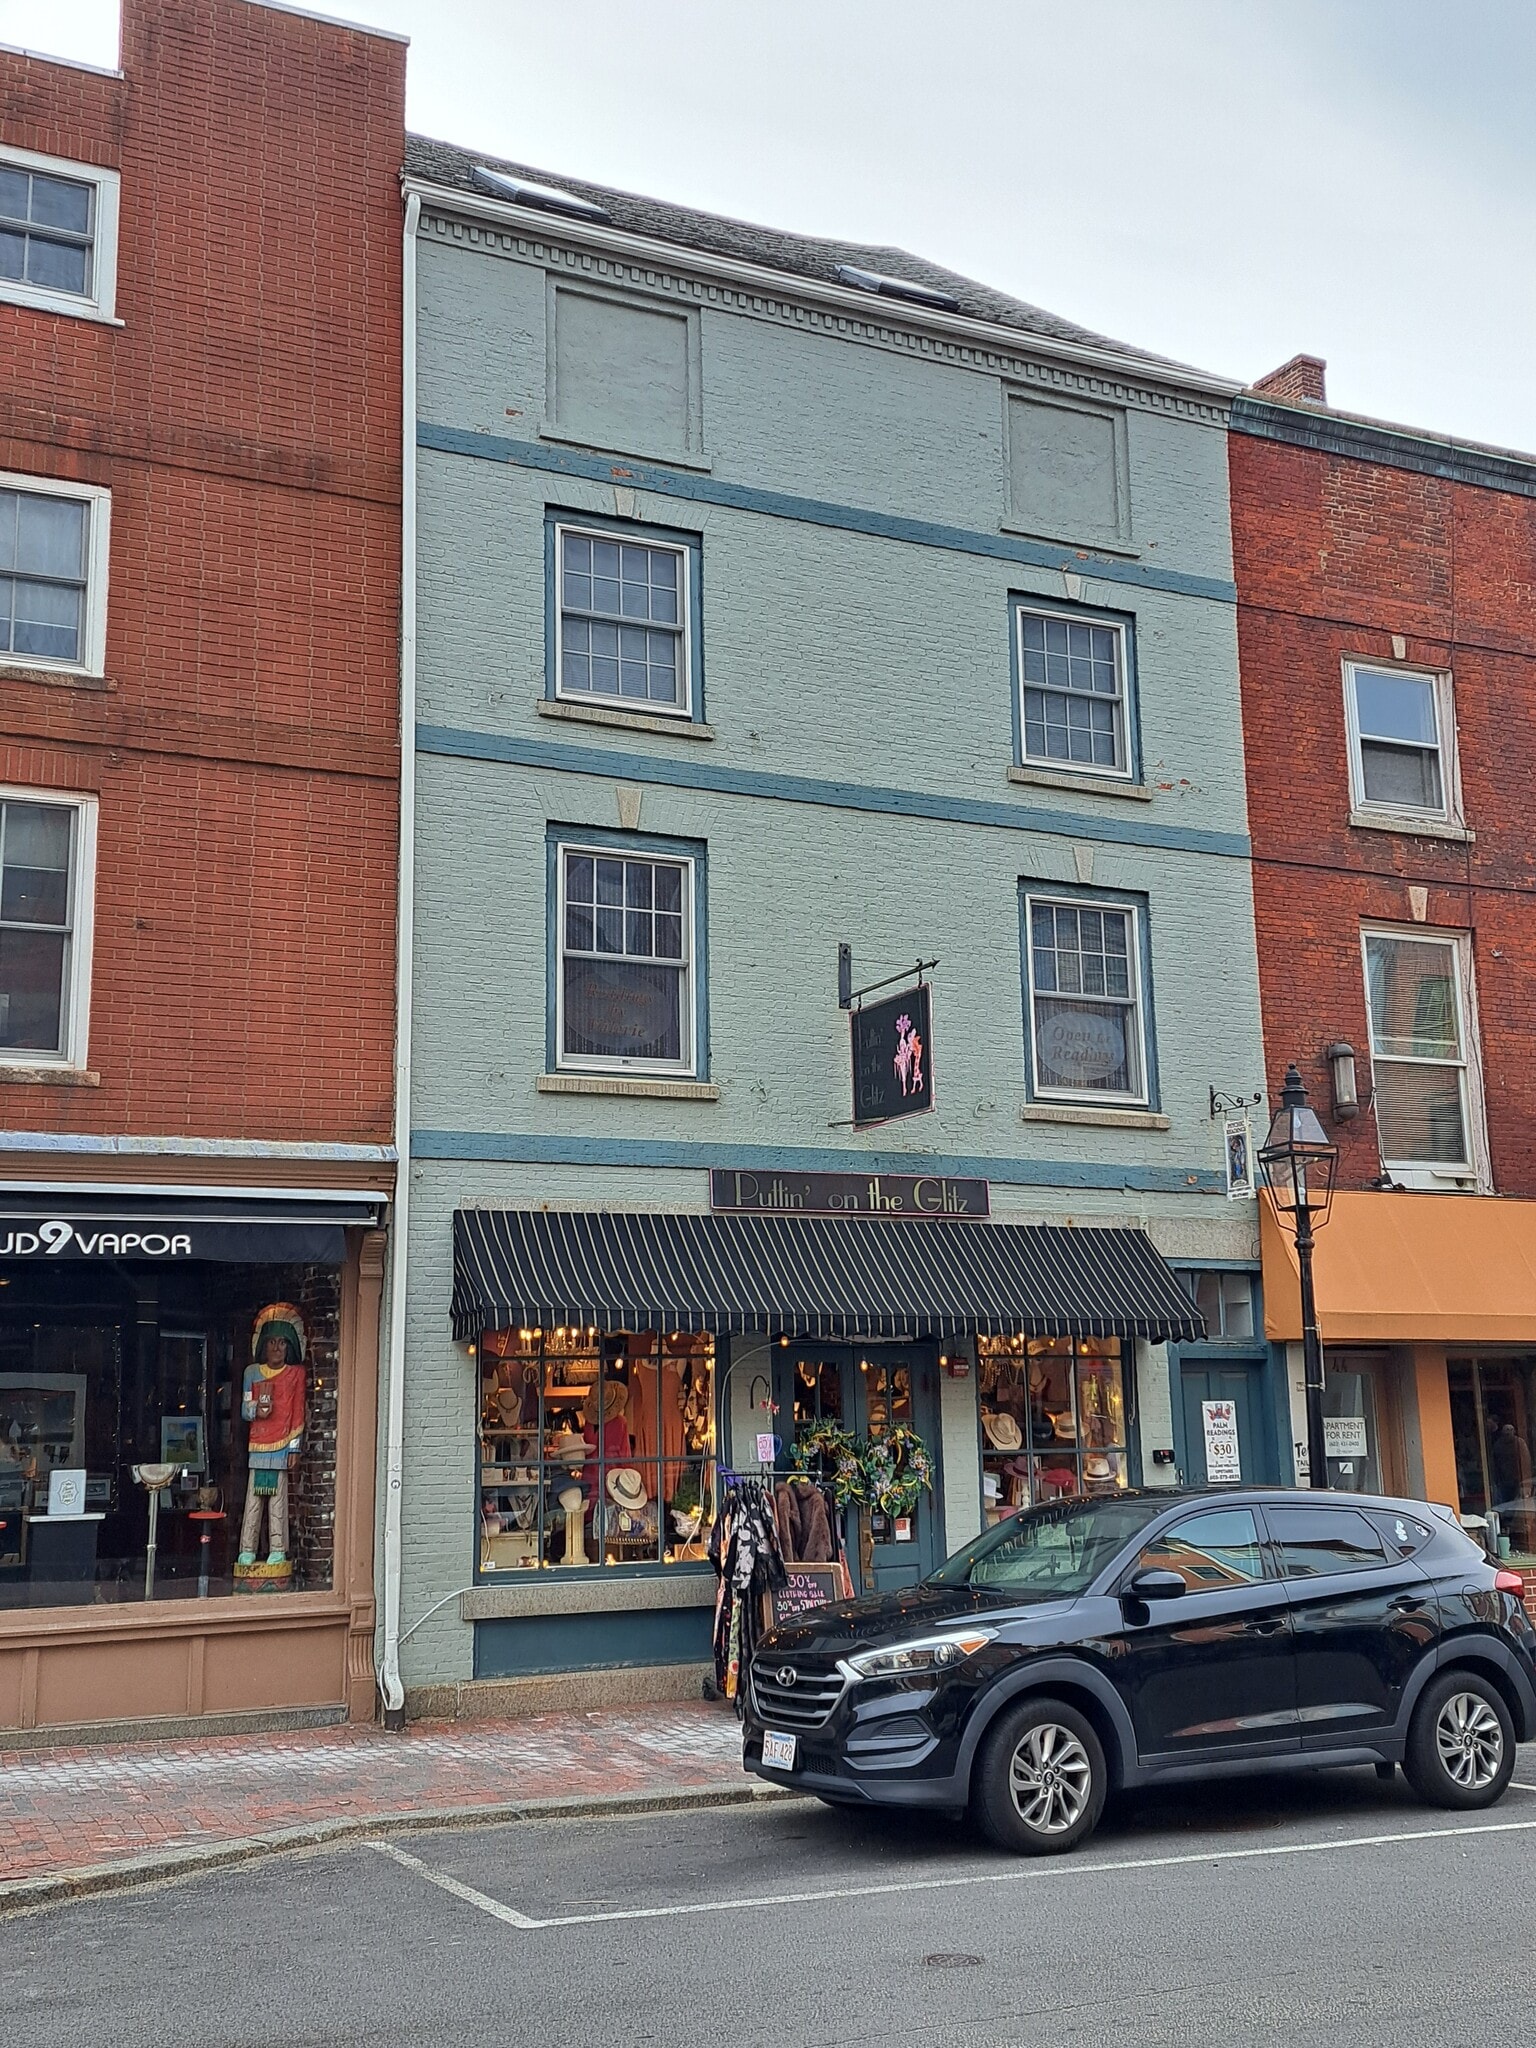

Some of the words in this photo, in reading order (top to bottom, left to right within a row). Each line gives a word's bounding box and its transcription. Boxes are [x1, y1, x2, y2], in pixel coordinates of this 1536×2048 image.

[1053, 1026, 1090, 1045] Open
[1052, 1046, 1115, 1064] Readings
[734, 1172, 811, 1208] Puttin'
[827, 1193, 859, 1209] on
[866, 1177, 904, 1211] the
[913, 1178, 969, 1214] Glitz
[1326, 1431, 1342, 1440] FOR
[1341, 1431, 1361, 1440] RENT
[1213, 1443, 1232, 1456] $30
[778, 1590, 807, 1598] CLOTHING
[809, 1590, 825, 1598] SALE
